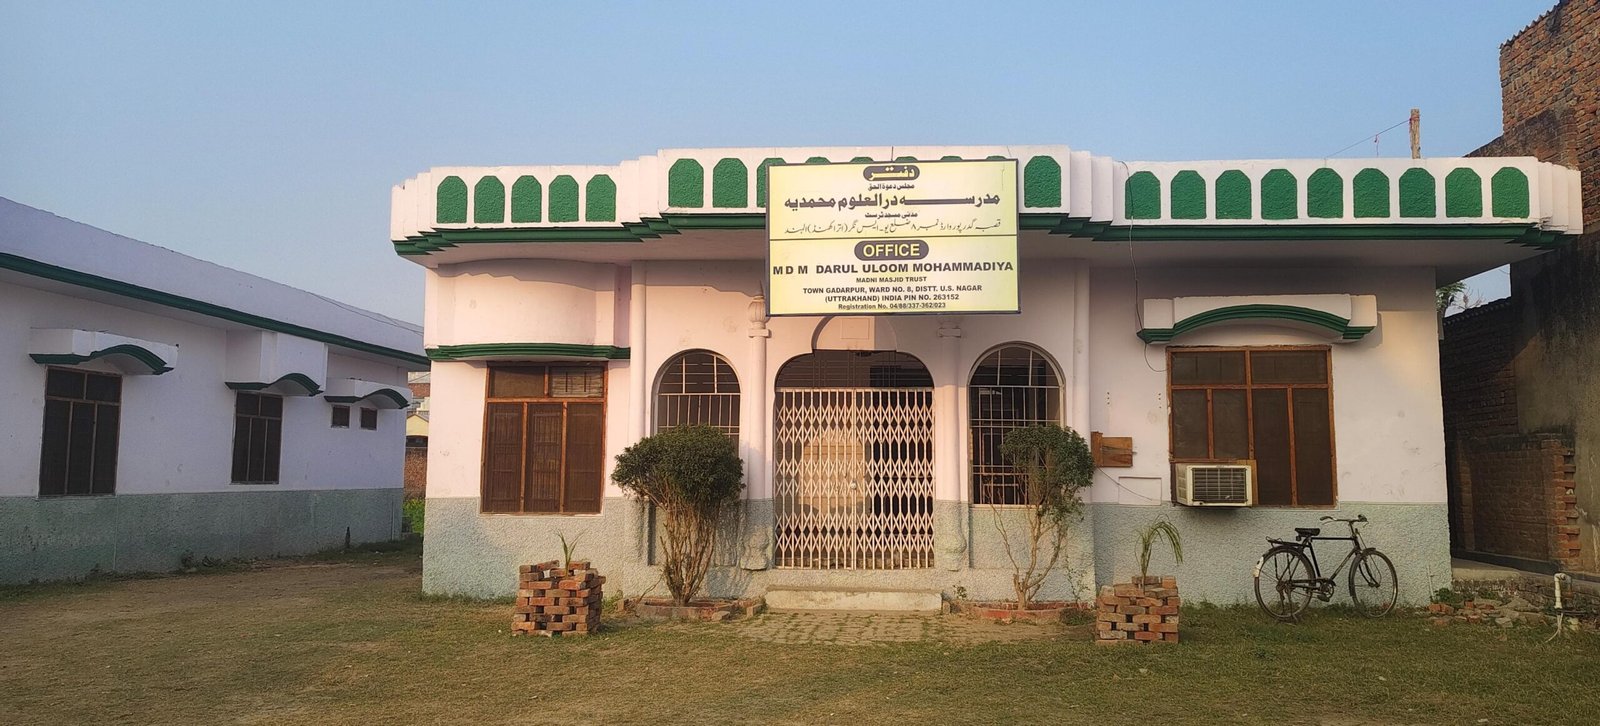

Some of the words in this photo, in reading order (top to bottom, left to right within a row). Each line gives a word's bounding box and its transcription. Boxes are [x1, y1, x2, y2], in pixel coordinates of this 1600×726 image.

[863, 243, 920, 257] OFFICE
[816, 264, 858, 274] DARUL
[862, 263, 909, 273] ULOOM
[912, 261, 1014, 273] MOHAMMADIYA
[825, 286, 868, 294] GADARPUR,
[824, 295, 880, 303] (UTTRAKHAND)
[838, 303, 876, 311] Registration
